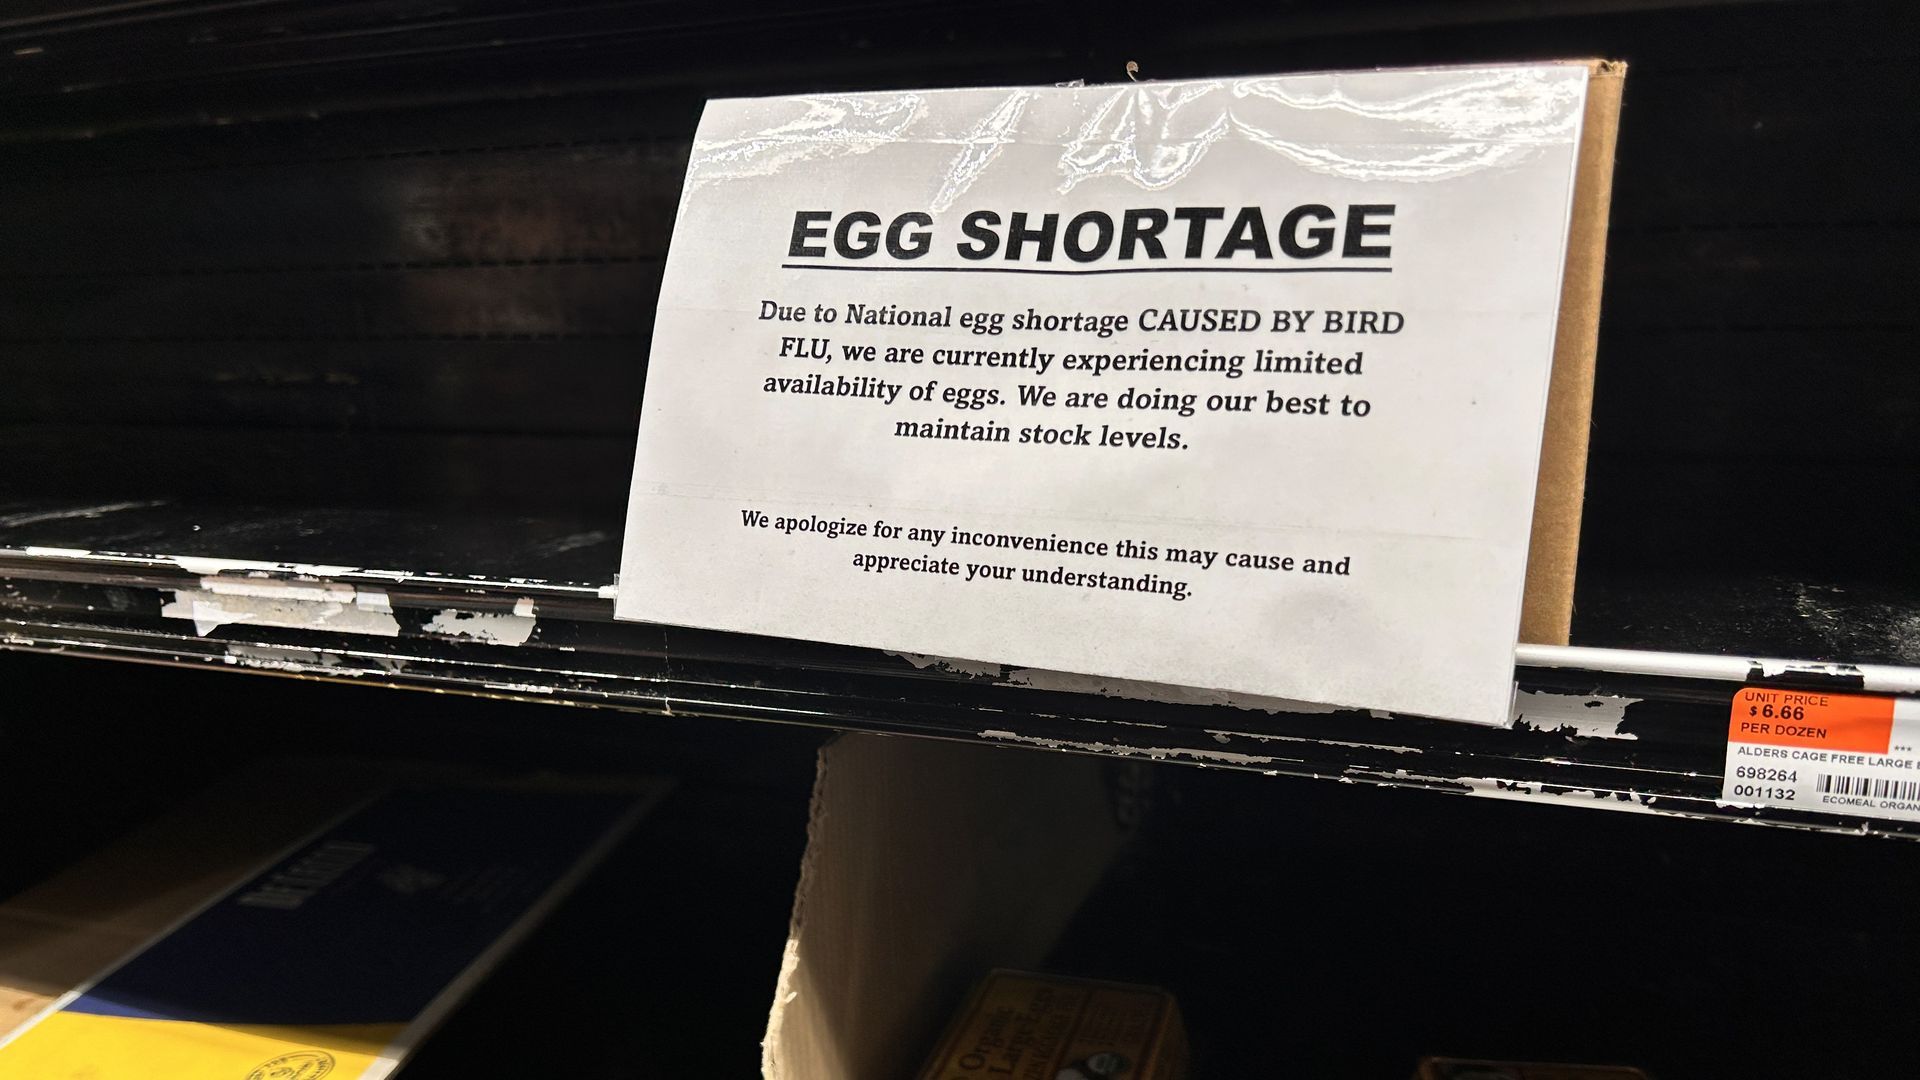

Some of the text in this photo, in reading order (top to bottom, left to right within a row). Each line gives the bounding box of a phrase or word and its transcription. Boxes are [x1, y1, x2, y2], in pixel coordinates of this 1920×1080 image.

[787, 203, 1396, 264] EGG SHORTAGE
[758, 300, 1405, 339] Due to National egg shortage CAUSED BY BIRD
[778, 336, 1363, 379] FLU, we are currently experiencing limited
[763, 373, 1371, 418] availability of eggs. We are doing our best to
[893, 417, 1188, 450] maintain stock levels.
[741, 509, 1351, 576] We apologize for any inconvenience this may cause and
[852, 553, 1192, 602] appreciate your understanding.
[1744, 691, 1829, 707] UNIT PRICE
[1762, 704, 1804, 721] 6.66
[1741, 722, 1827, 739] PER DOZEN
[1738, 746, 1788, 759] ALDERS
[1792, 750, 1828, 763] CAGE
[1831, 754, 1865, 766] FREE
[1868, 756, 1913, 770] LARGE
[1736, 765, 1798, 783] 698264
[1734, 784, 1796, 801] 001132
[1822, 795, 1876, 808] ECOMEAL
